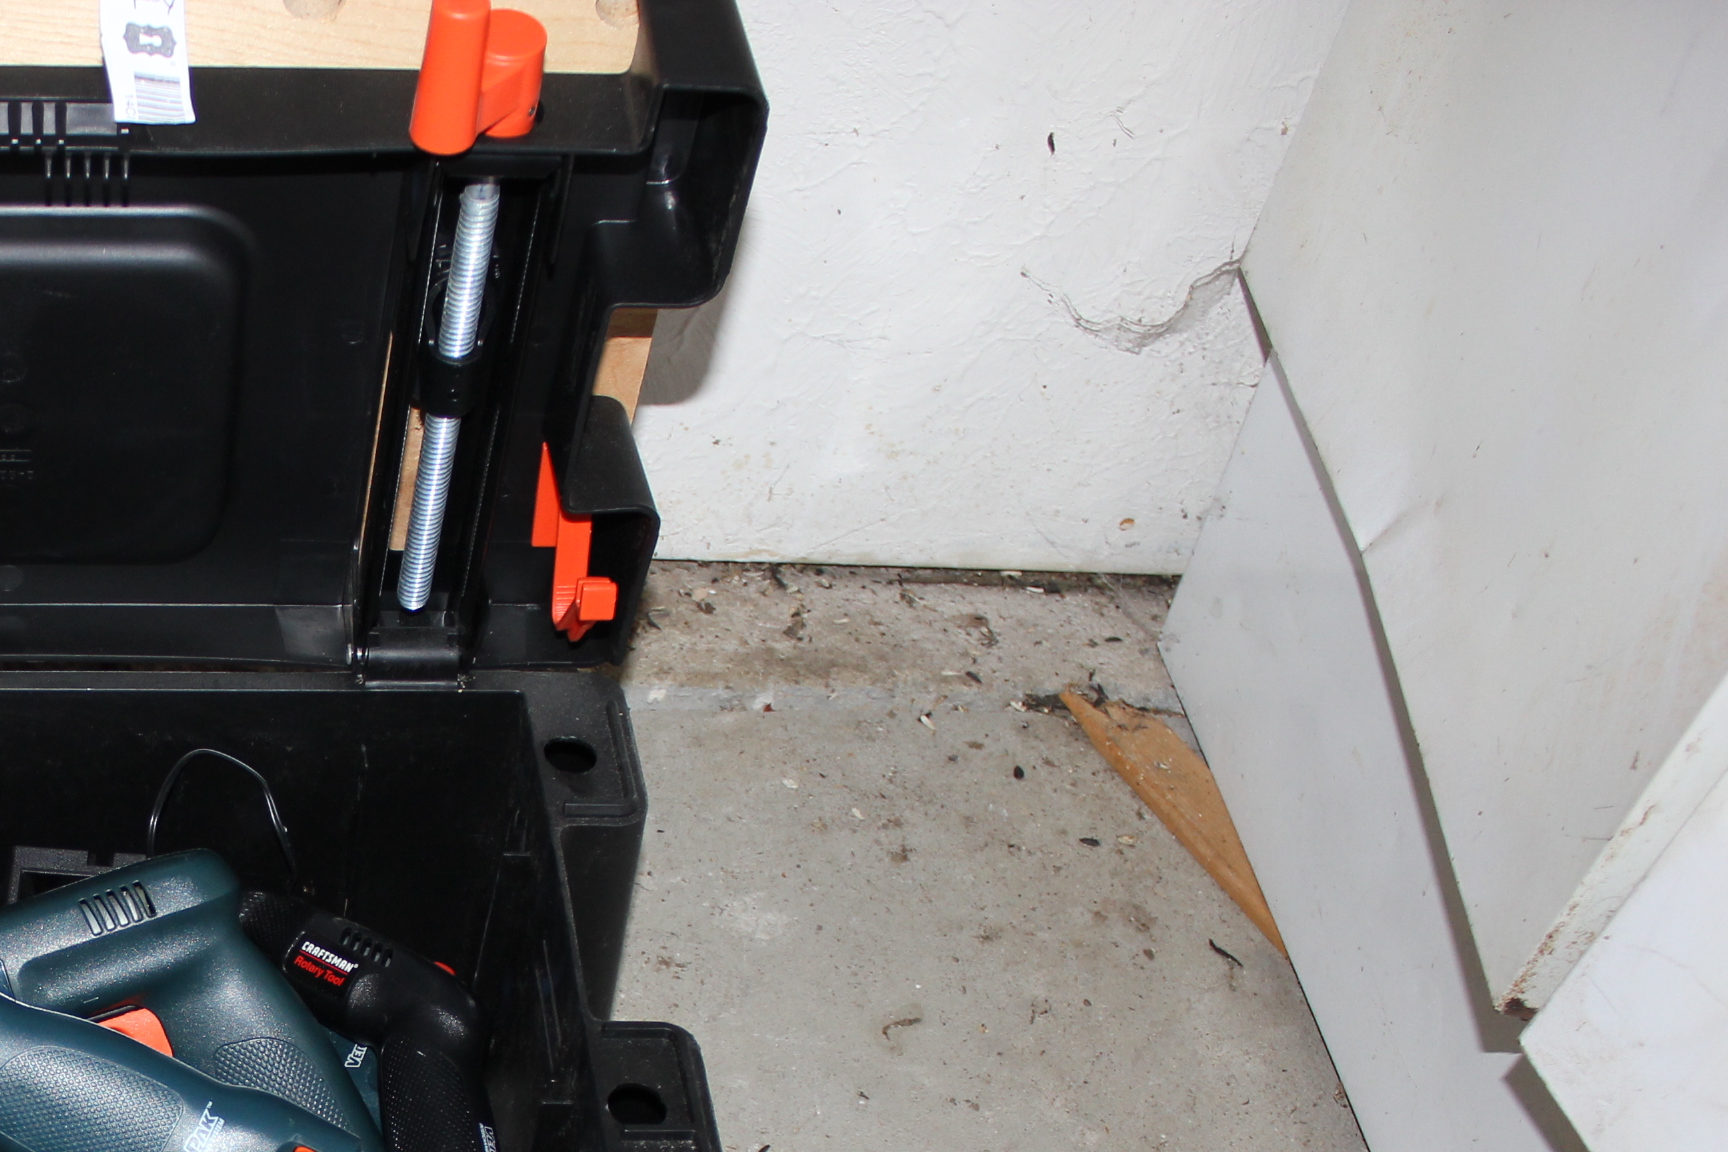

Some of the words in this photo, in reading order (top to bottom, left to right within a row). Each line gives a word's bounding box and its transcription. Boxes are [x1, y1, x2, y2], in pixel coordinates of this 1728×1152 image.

[294, 955, 324, 978] Rotary
[324, 969, 346, 987] Tool
[301, 941, 354, 973] CRAFTSMAN
